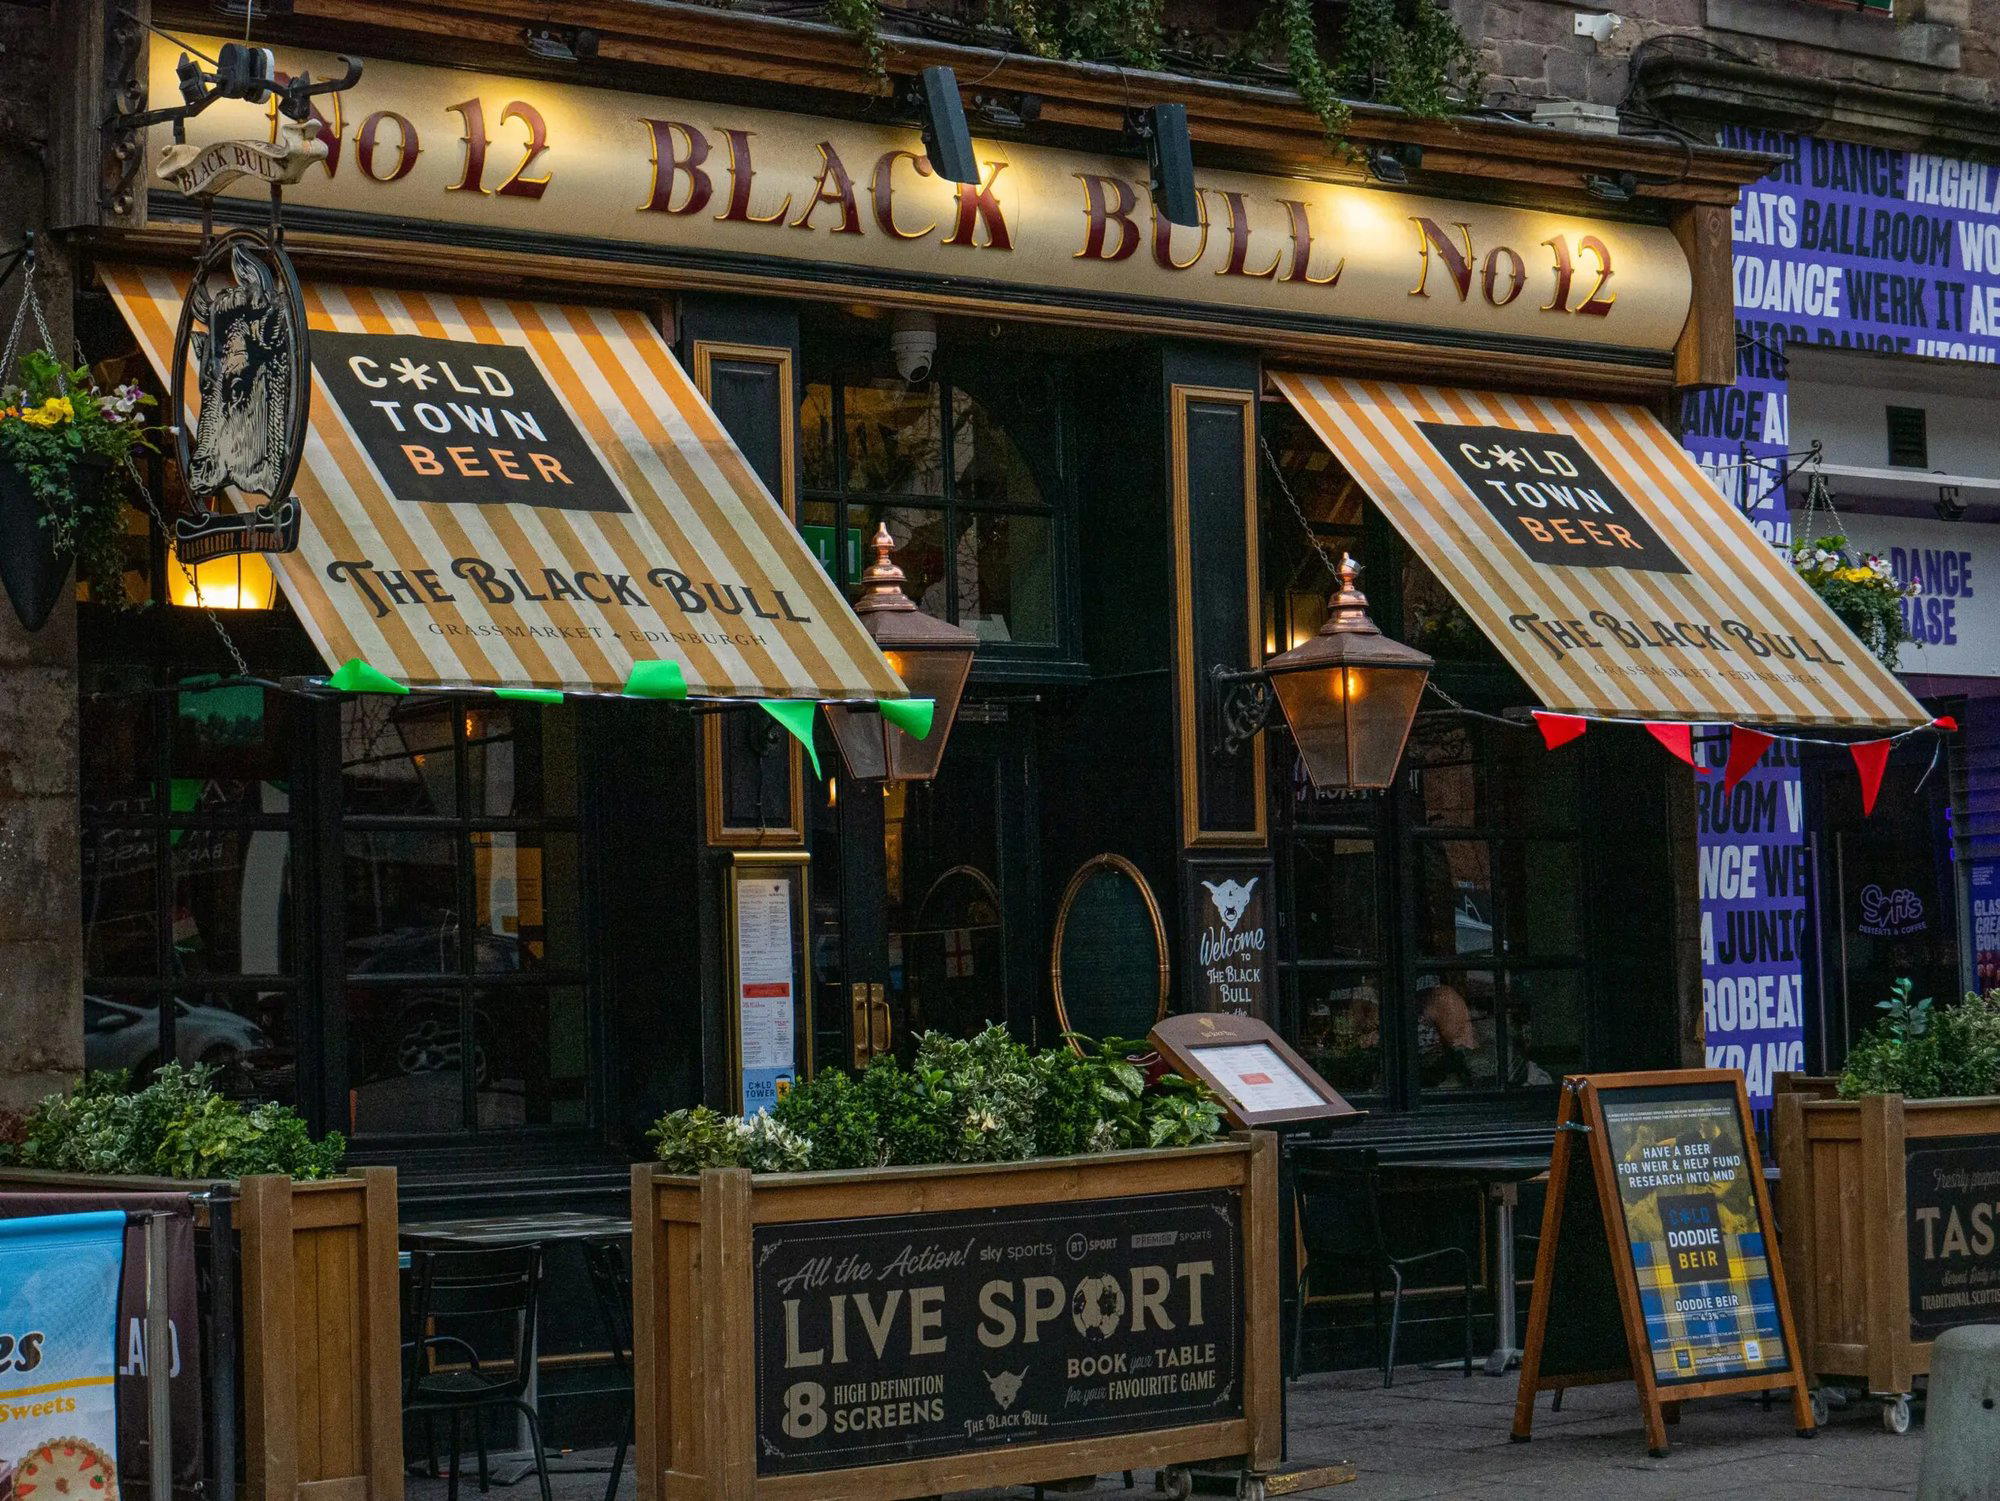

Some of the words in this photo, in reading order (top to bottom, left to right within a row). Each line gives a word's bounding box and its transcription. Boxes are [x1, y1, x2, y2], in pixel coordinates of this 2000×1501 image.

[182, 145, 228, 192] BLACK
[233, 147, 276, 178] BULL
[1811, 139, 1905, 200] DANCE
[445, 97, 553, 199] 12
[636, 117, 1014, 252] BLACK
[1071, 171, 1346, 287] BULL
[1408, 215, 1528, 306] No
[1540, 233, 1617, 317] 12
[1800, 199, 1952, 267] BALLROOM
[1844, 268, 1929, 328] WERK
[1934, 281, 1965, 331] IT
[369, 400, 548, 442] TOWN
[400, 444, 575, 485] BEER
[1485, 479, 1615, 515] TOWN
[1517, 516, 1644, 550] BEER
[326, 559, 456, 619] THE
[450, 556, 650, 609] BLACK
[646, 567, 812, 624] BULL
[1890, 547, 1974, 598] DANCE
[428, 622, 603, 641] GRASSMARKET
[631, 628, 768, 647] EDINBURGH
[1508, 612, 1605, 661] THE
[1588, 609, 1734, 652] BLACK
[1720, 618, 1846, 667] BULL
[1594, 663, 1713, 680] GRASSMARKET
[1729, 671, 1823, 686] EDINBURGH
[1201, 926, 1265, 966] Welcome
[1241, 952, 1251, 962] TO
[1207, 966, 1225, 985] THE
[1225, 965, 1261, 984] BLACK
[1220, 983, 1252, 1003] BULL
[746, 1089, 776, 1099] TOWER
[1618, 1161, 1639, 1175] FOR
[1641, 1159, 1668, 1173] WEIR
[1672, 1160, 1679, 1171] &
[1683, 1157, 1709, 1170] HELP
[1713, 1155, 1741, 1168] FUND
[1643, 1146, 1670, 1160] HAVE
[1674, 1147, 1681, 1157] A
[1684, 1143, 1711, 1156] BEER
[1629, 1172, 1683, 1189] RESEARCH
[1686, 1171, 1710, 1184] INTO
[1713, 1168, 1735, 1182] MND
[1668, 1227, 1720, 1249] DODDIE
[1915, 1202, 2000, 1260] TAS
[777, 1257, 833, 1295] All
[834, 1254, 874, 1284] the
[877, 1238, 976, 1282] Action!
[980, 1244, 1002, 1261] sky
[1007, 1242, 1054, 1260] sports
[1071, 1241, 1084, 1252] BT
[1089, 1238, 1118, 1251] SPORT
[1178, 1230, 1213, 1241] SPORTS
[1678, 1249, 1718, 1270] BEIR
[783, 1285, 948, 1369] LIVE
[977, 1259, 1216, 1349] SPORT
[1675, 1297, 1713, 1313] DODDIE
[1715, 1294, 1739, 1308] BEIR
[1921, 1291, 1971, 1311] TRADITIONAL
[1067, 1352, 1127, 1380] BOOK
[1155, 1343, 1216, 1369] TABLE
[781, 1381, 828, 1439] 8
[833, 1382, 867, 1405] HIGH
[871, 1374, 944, 1401] DEFINITION
[1064, 1385, 1081, 1409] for
[1083, 1386, 1107, 1407] your
[1108, 1374, 1177, 1401] FAVOURITE
[1181, 1369, 1216, 1392] GAME
[0, 1396, 77, 1424] Sweets
[833, 1398, 945, 1434] SCREENS
[963, 1419, 985, 1438] THE
[985, 1414, 1020, 1431] BLACK
[1022, 1410, 1049, 1427] BULL
